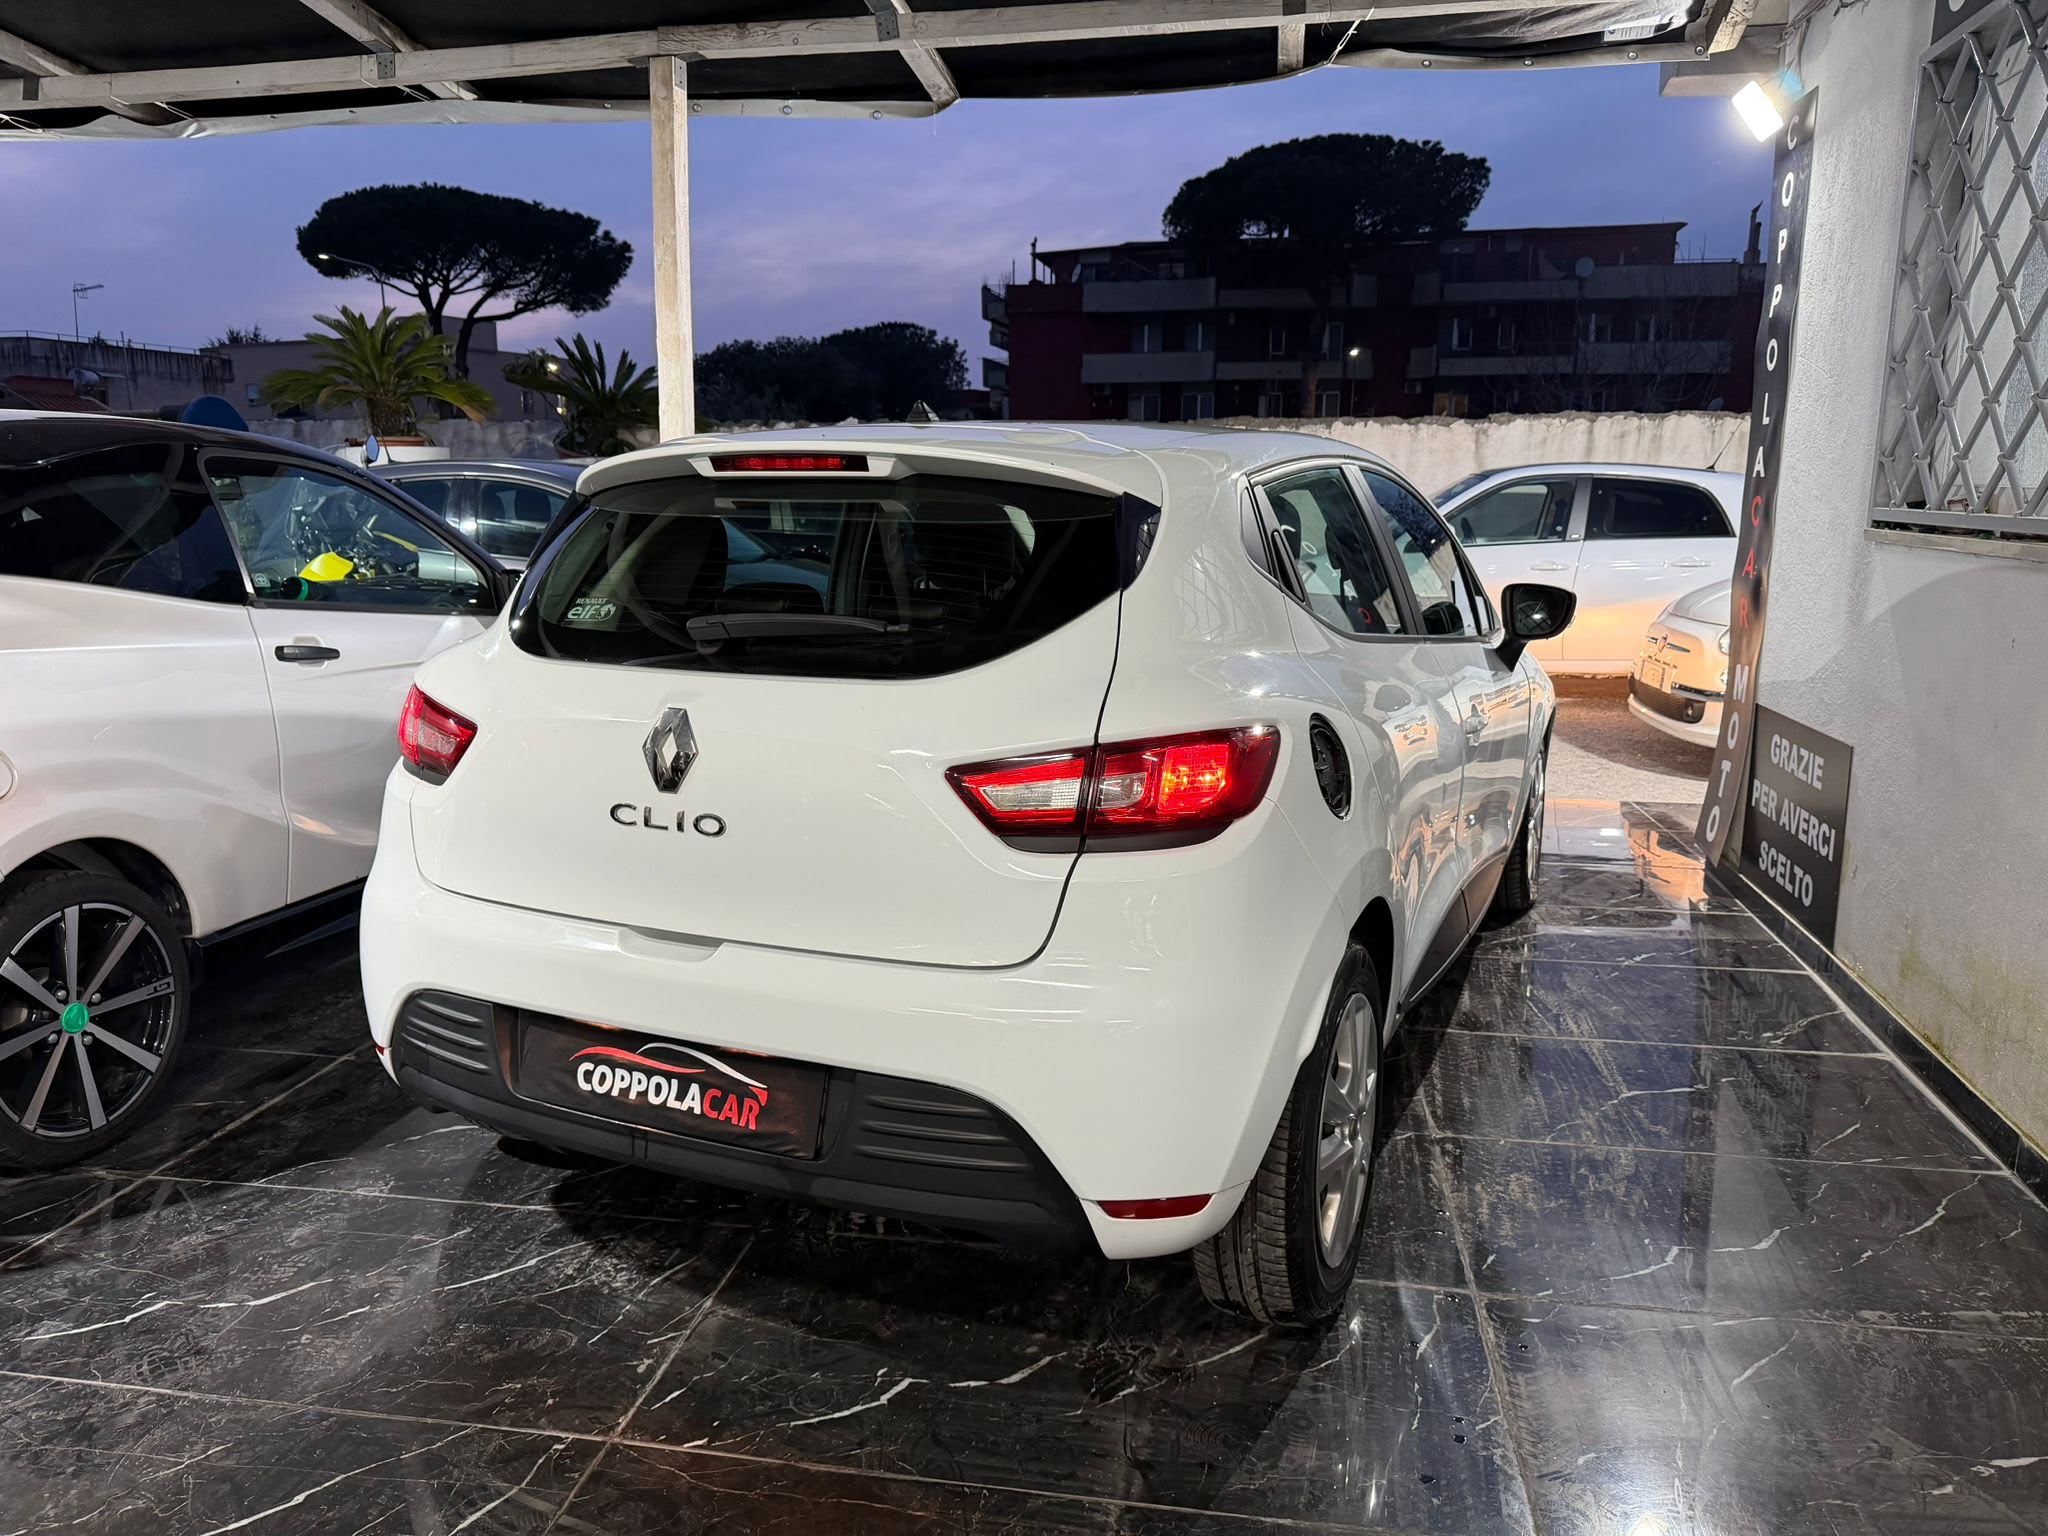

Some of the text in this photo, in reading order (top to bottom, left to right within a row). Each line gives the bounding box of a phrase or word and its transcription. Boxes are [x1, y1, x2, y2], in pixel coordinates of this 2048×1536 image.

[1705, 663, 1750, 842] MOTO
[1770, 734, 1824, 790] GRAZIE
[610, 802, 727, 837] CLIO
[1751, 778, 1836, 862] PER AVERCI
[1758, 840, 1814, 907] SCELTO
[576, 1061, 761, 1130] COPPOLACAR
